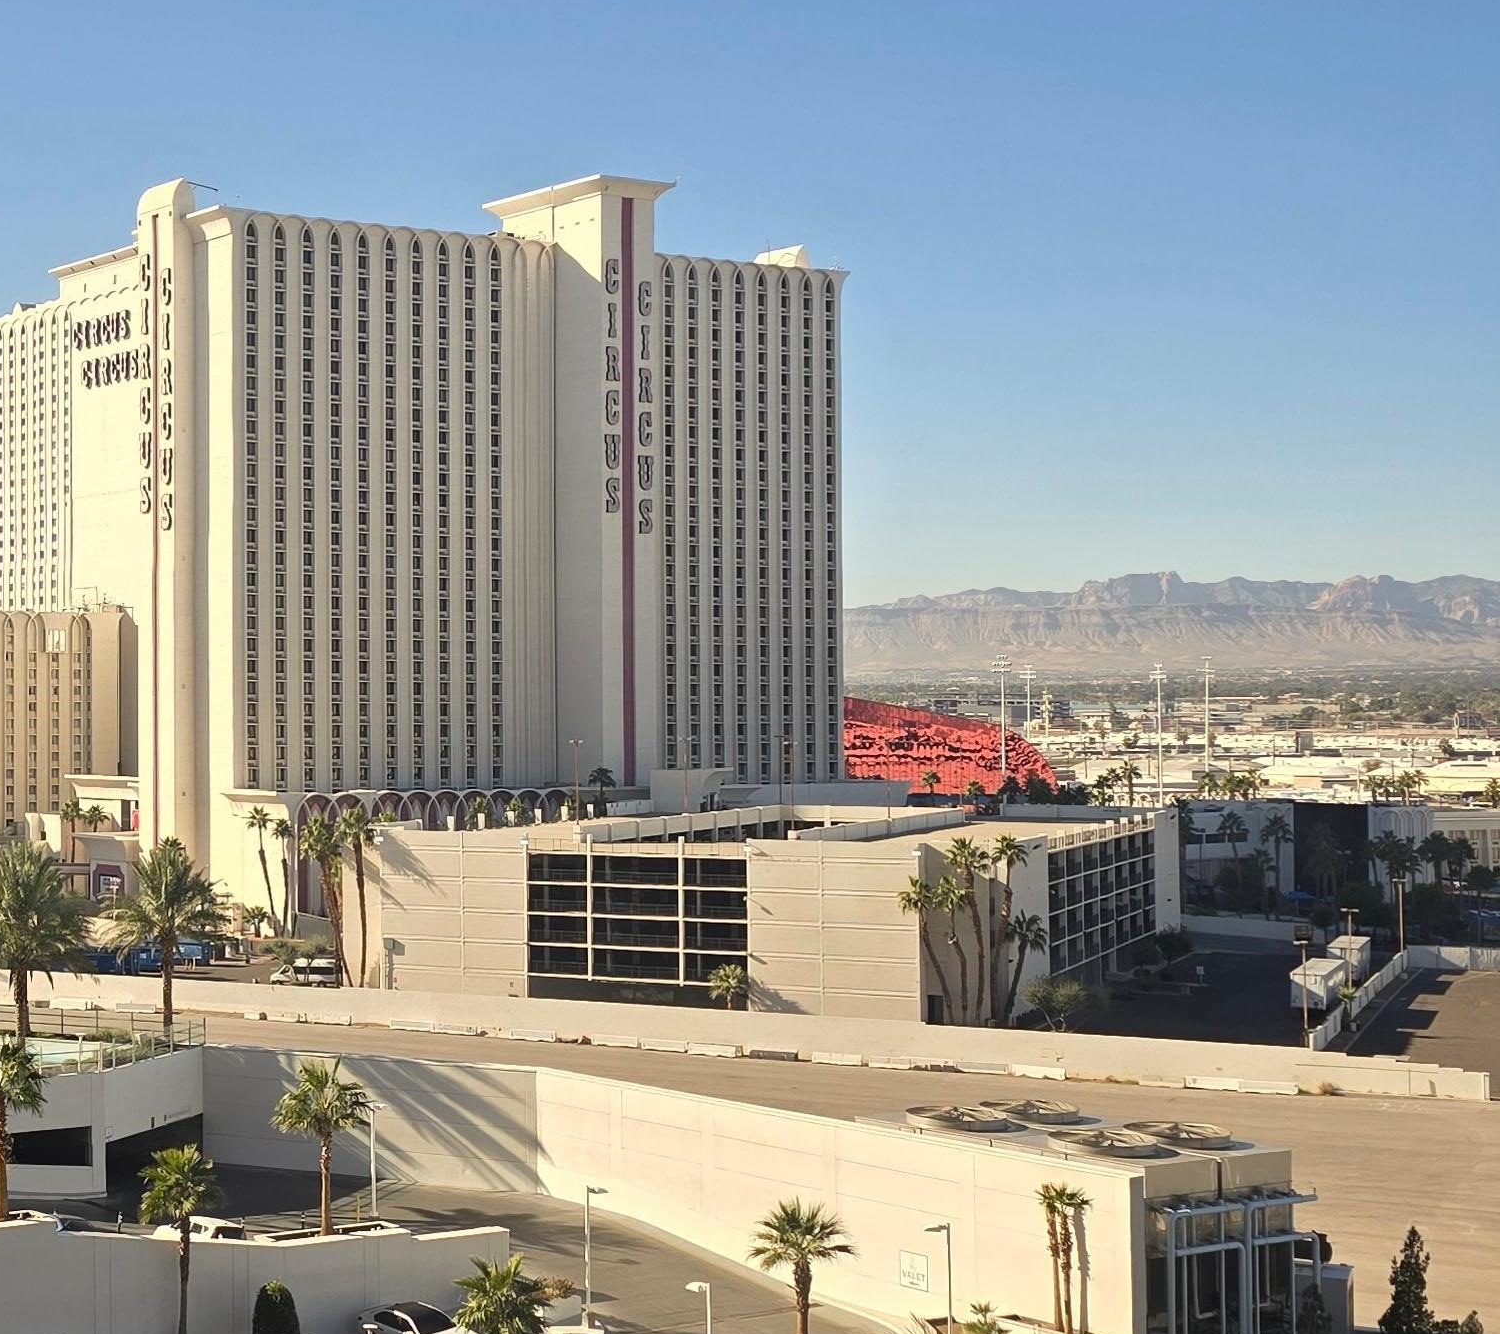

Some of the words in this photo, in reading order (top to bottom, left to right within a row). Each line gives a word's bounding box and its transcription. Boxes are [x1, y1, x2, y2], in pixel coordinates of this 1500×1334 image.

[72, 309, 131, 351] CIRCUS
[81, 349, 139, 390] CIRCUS
[139, 253, 152, 514] CIRCUS
[160, 267, 173, 531] CIRCUS
[604, 258, 621, 513] CIRCUS
[637, 280, 654, 534] CIRCUS
[902, 1270, 925, 1282] VALET
